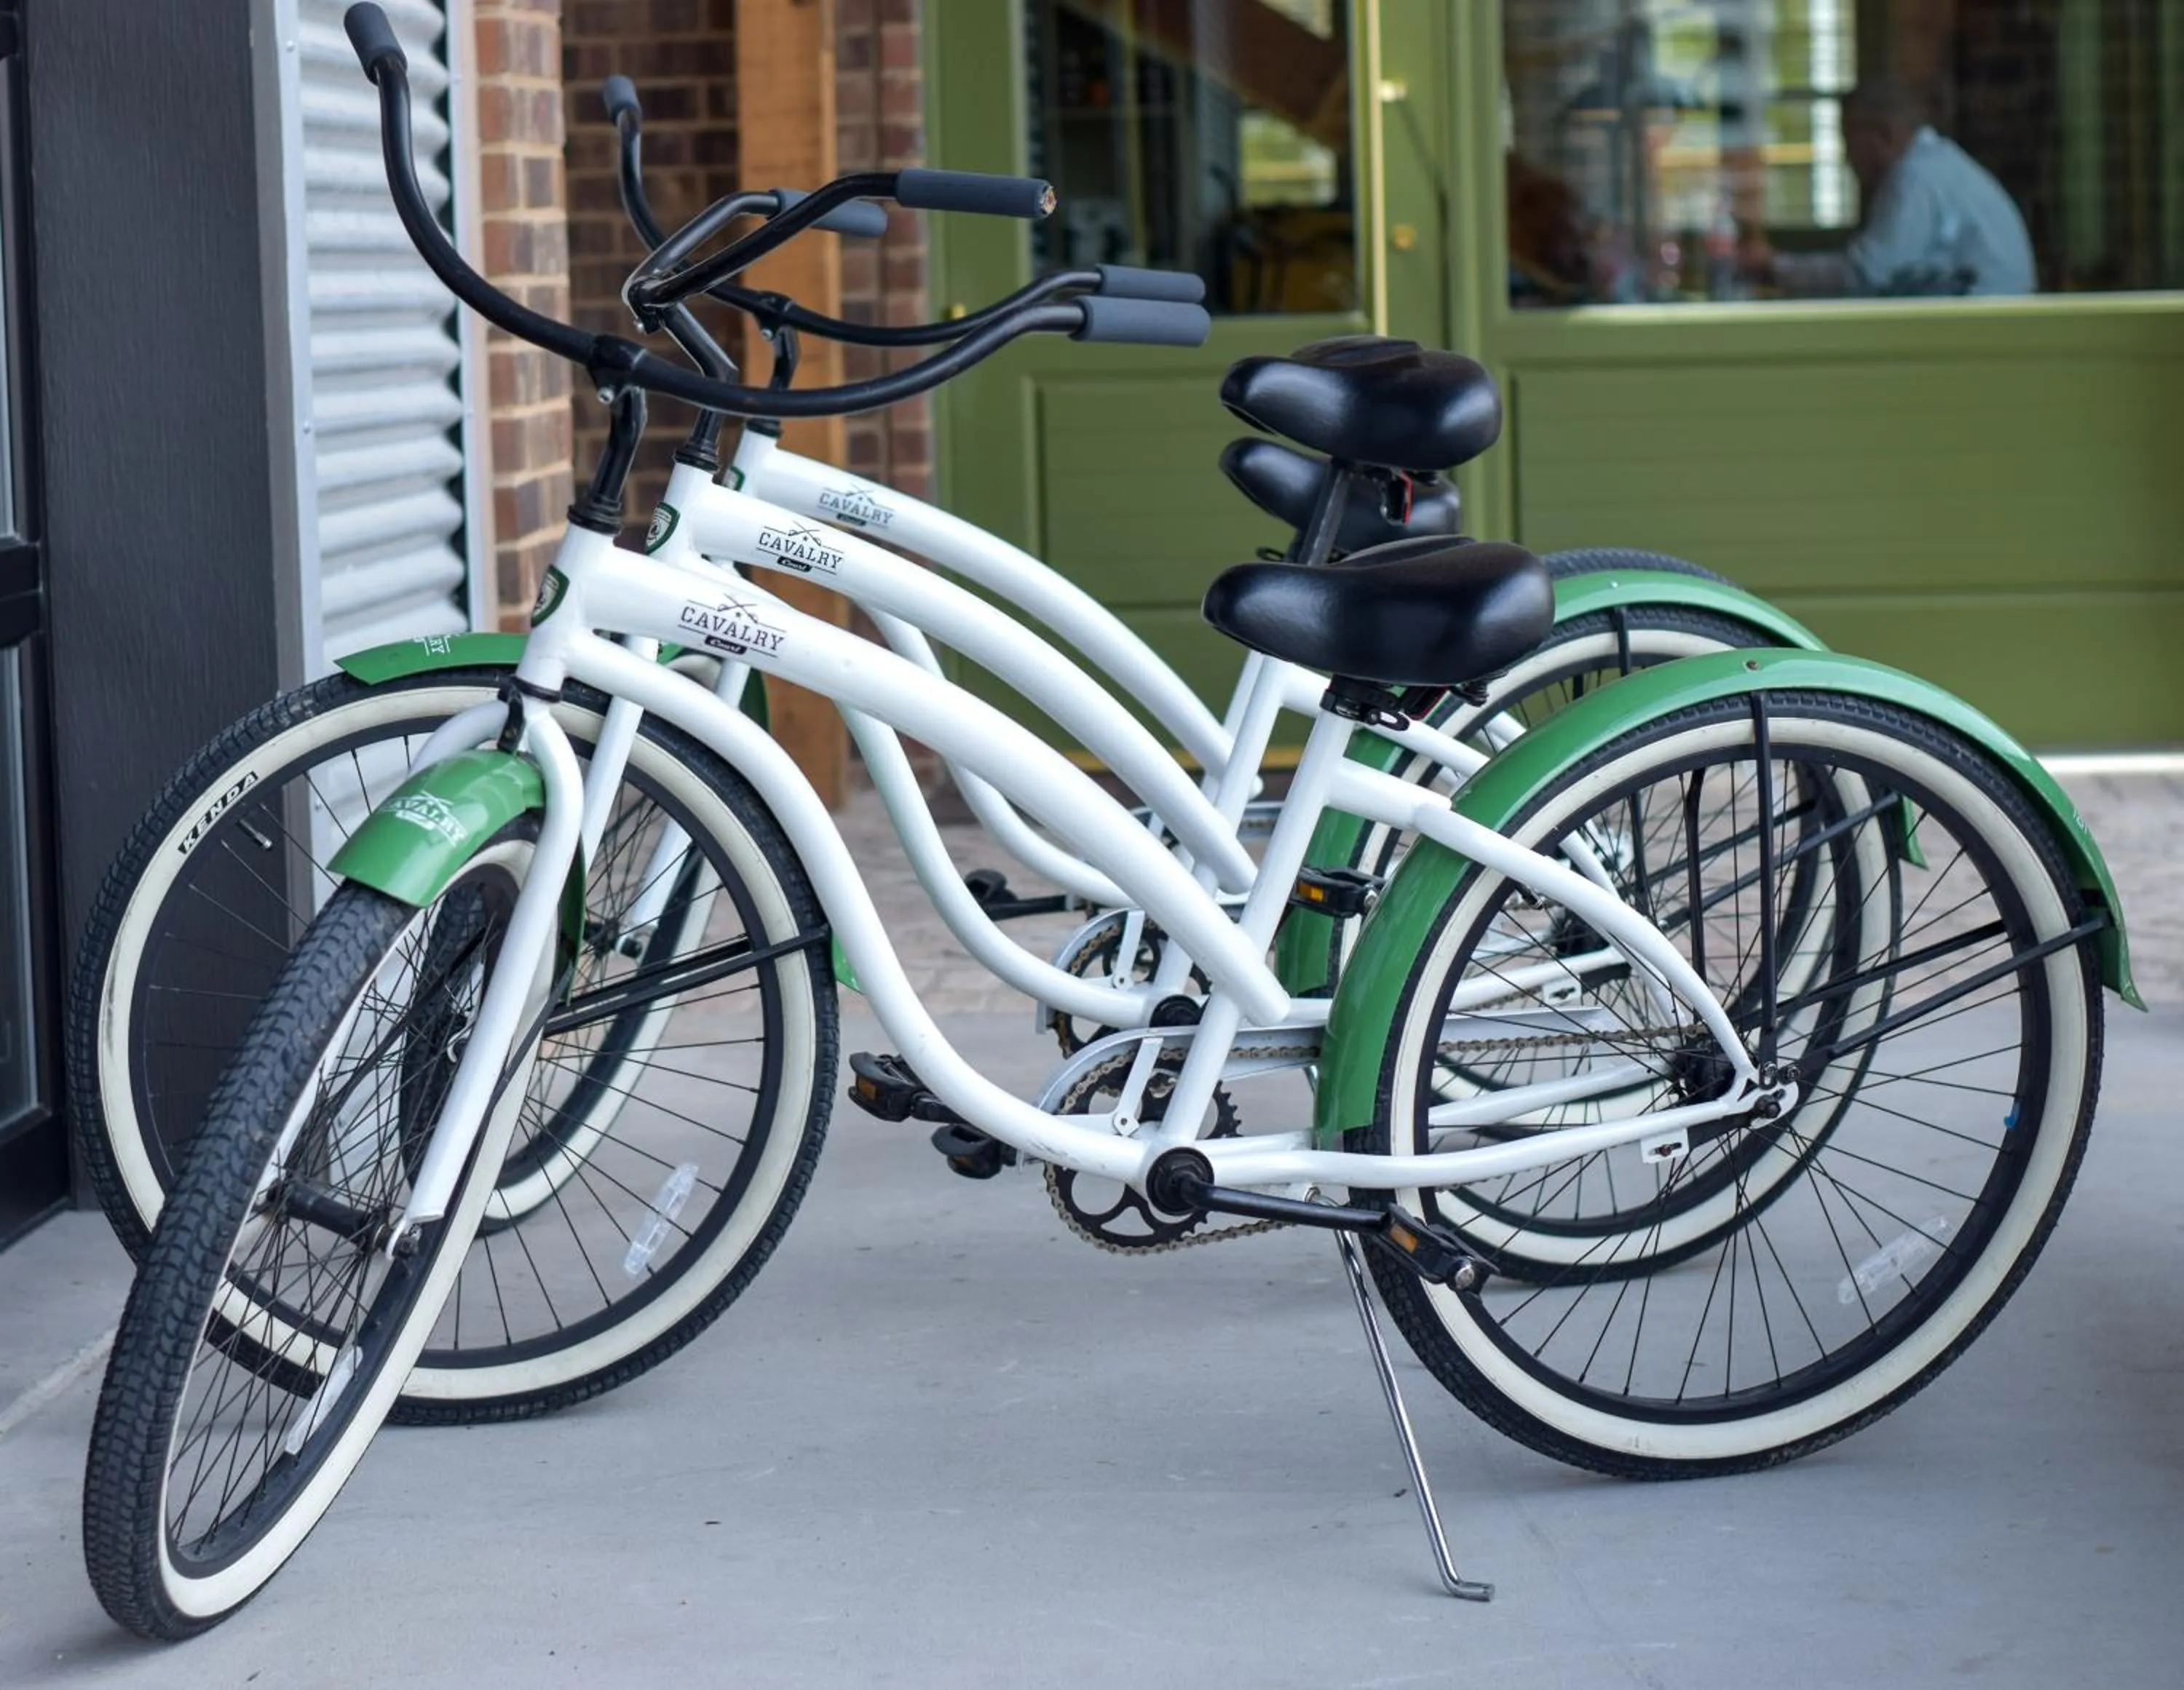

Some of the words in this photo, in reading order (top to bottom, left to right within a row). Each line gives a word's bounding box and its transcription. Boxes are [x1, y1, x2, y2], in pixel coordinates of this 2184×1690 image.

[819, 493, 895, 525] CAVALRY
[759, 532, 843, 570] CAVALRY
[681, 606, 786, 651] CAVALRY
[182, 771, 257, 852] KENDA
